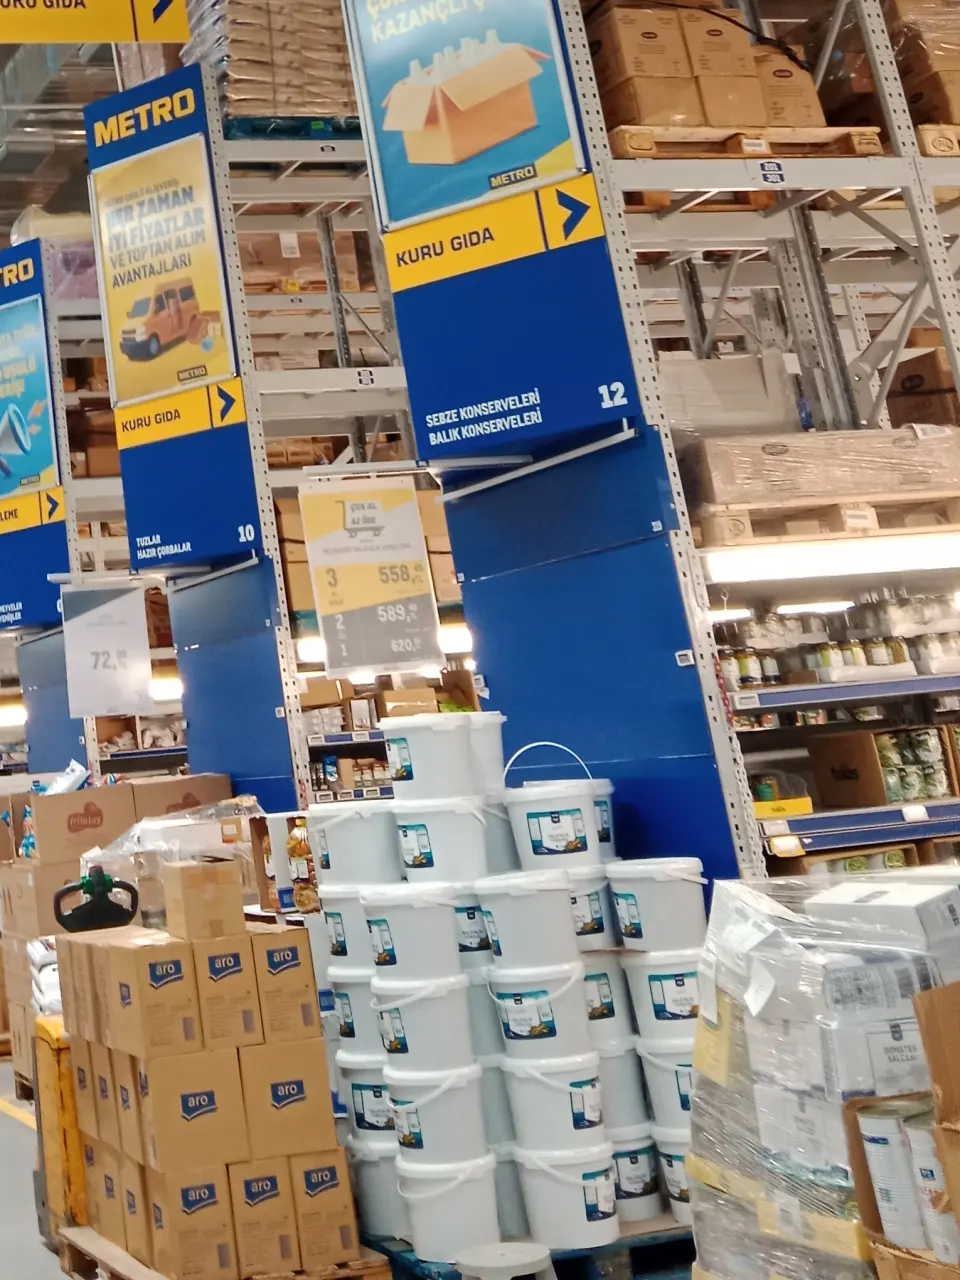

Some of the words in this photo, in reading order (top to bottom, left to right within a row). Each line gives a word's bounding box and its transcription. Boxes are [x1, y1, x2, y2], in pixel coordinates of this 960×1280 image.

[94, 87, 195, 148] METRO
[491, 167, 534, 187] METRO
[138, 186, 194, 216] ZAMAN
[109, 251, 125, 270] VE
[126, 238, 174, 267] TOPTAN
[176, 228, 206, 249] ALIM
[396, 239, 444, 267] KURU
[451, 227, 494, 252] GIDA
[112, 253, 193, 289] AVANTAJLARI
[598, 381, 628, 409] 12
[426, 408, 459, 428] SEBZE
[460, 387, 540, 420] KONSERVELERİ
[121, 413, 152, 432] KURU
[154, 409, 181, 425] GIDA
[429, 426, 461, 446] BALIK
[461, 407, 543, 439] KONSERVELERİ
[136, 534, 161, 548] TUZLAR
[238, 524, 255, 543] 10
[137, 546, 157, 560] HAZIR
[157, 541, 192, 560] ÇORBALAR
[326, 567, 339, 588] 3
[335, 614, 346, 630] 2
[341, 643, 348, 656] 1
[214, 954, 234, 968] aro
[273, 949, 293, 962] aro
[156, 961, 175, 975] aro
[276, 1083, 297, 1096] aro
[187, 1093, 207, 1108] aro
[251, 1178, 271, 1192] aro
[310, 1169, 330, 1183] aro
[187, 1186, 208, 1202] aro
